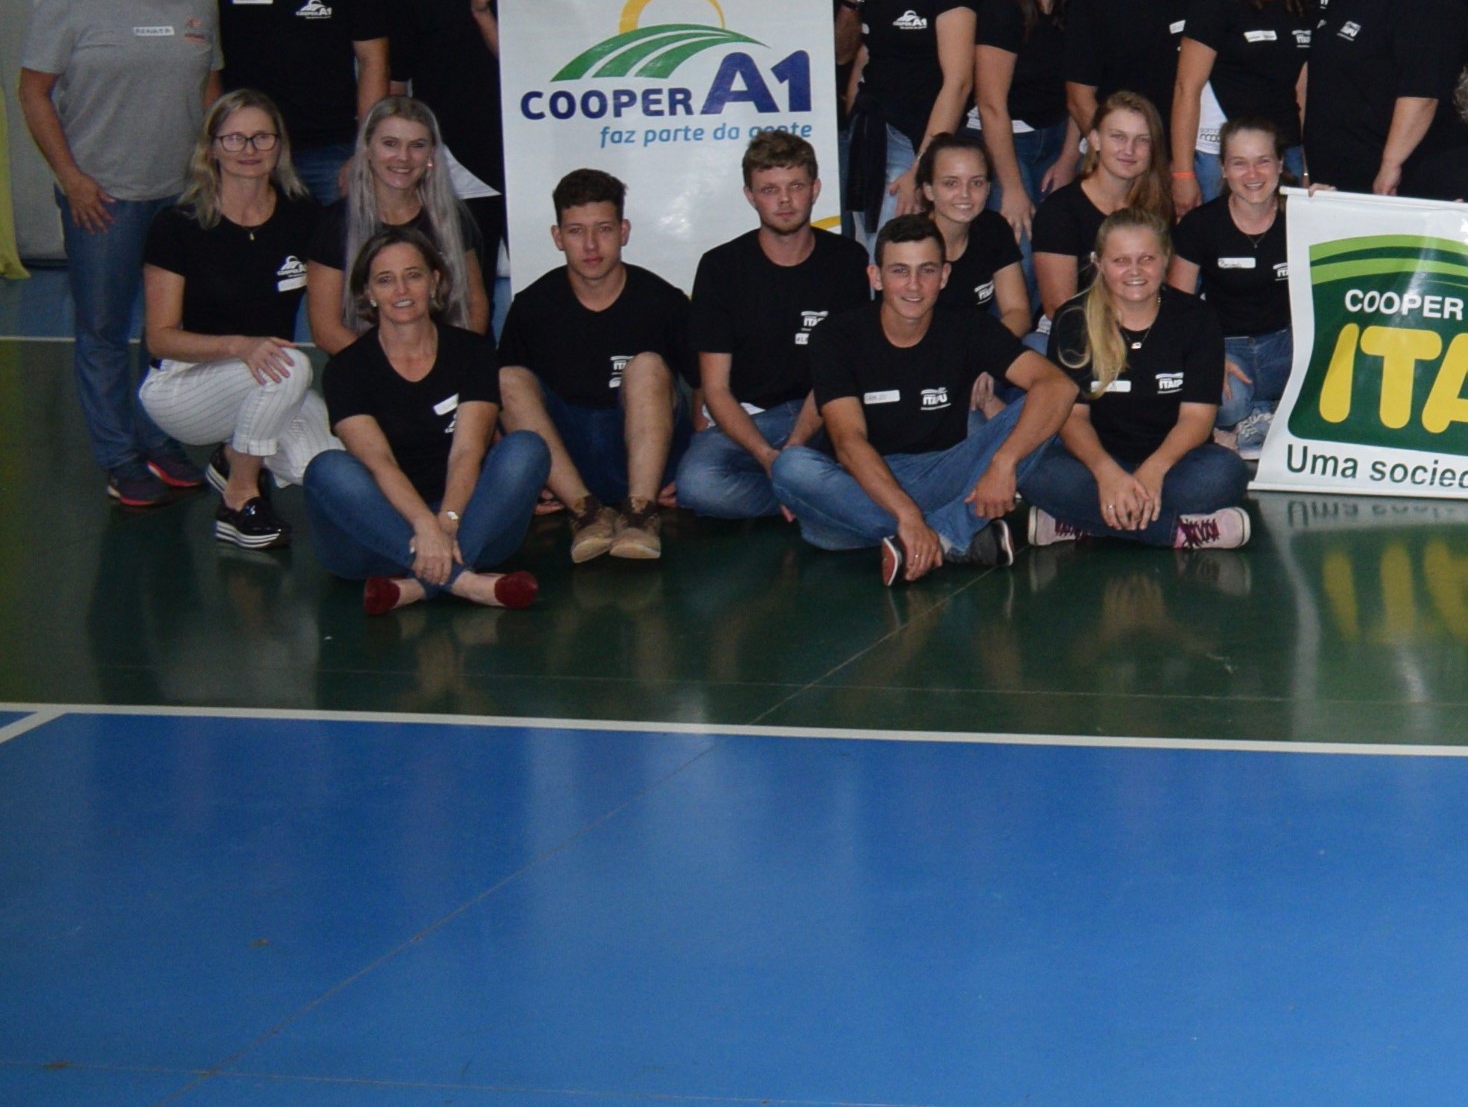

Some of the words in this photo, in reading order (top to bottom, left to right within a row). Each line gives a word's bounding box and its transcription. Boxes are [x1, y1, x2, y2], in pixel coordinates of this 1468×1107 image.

[520, 87, 694, 120] COOPER
[700, 50, 812, 115] A1
[600, 126, 636, 148] faz
[644, 124, 705, 146] parte
[713, 123, 740, 141] da
[1344, 289, 1464, 321] COOPER
[1286, 444, 1359, 479] Uma
